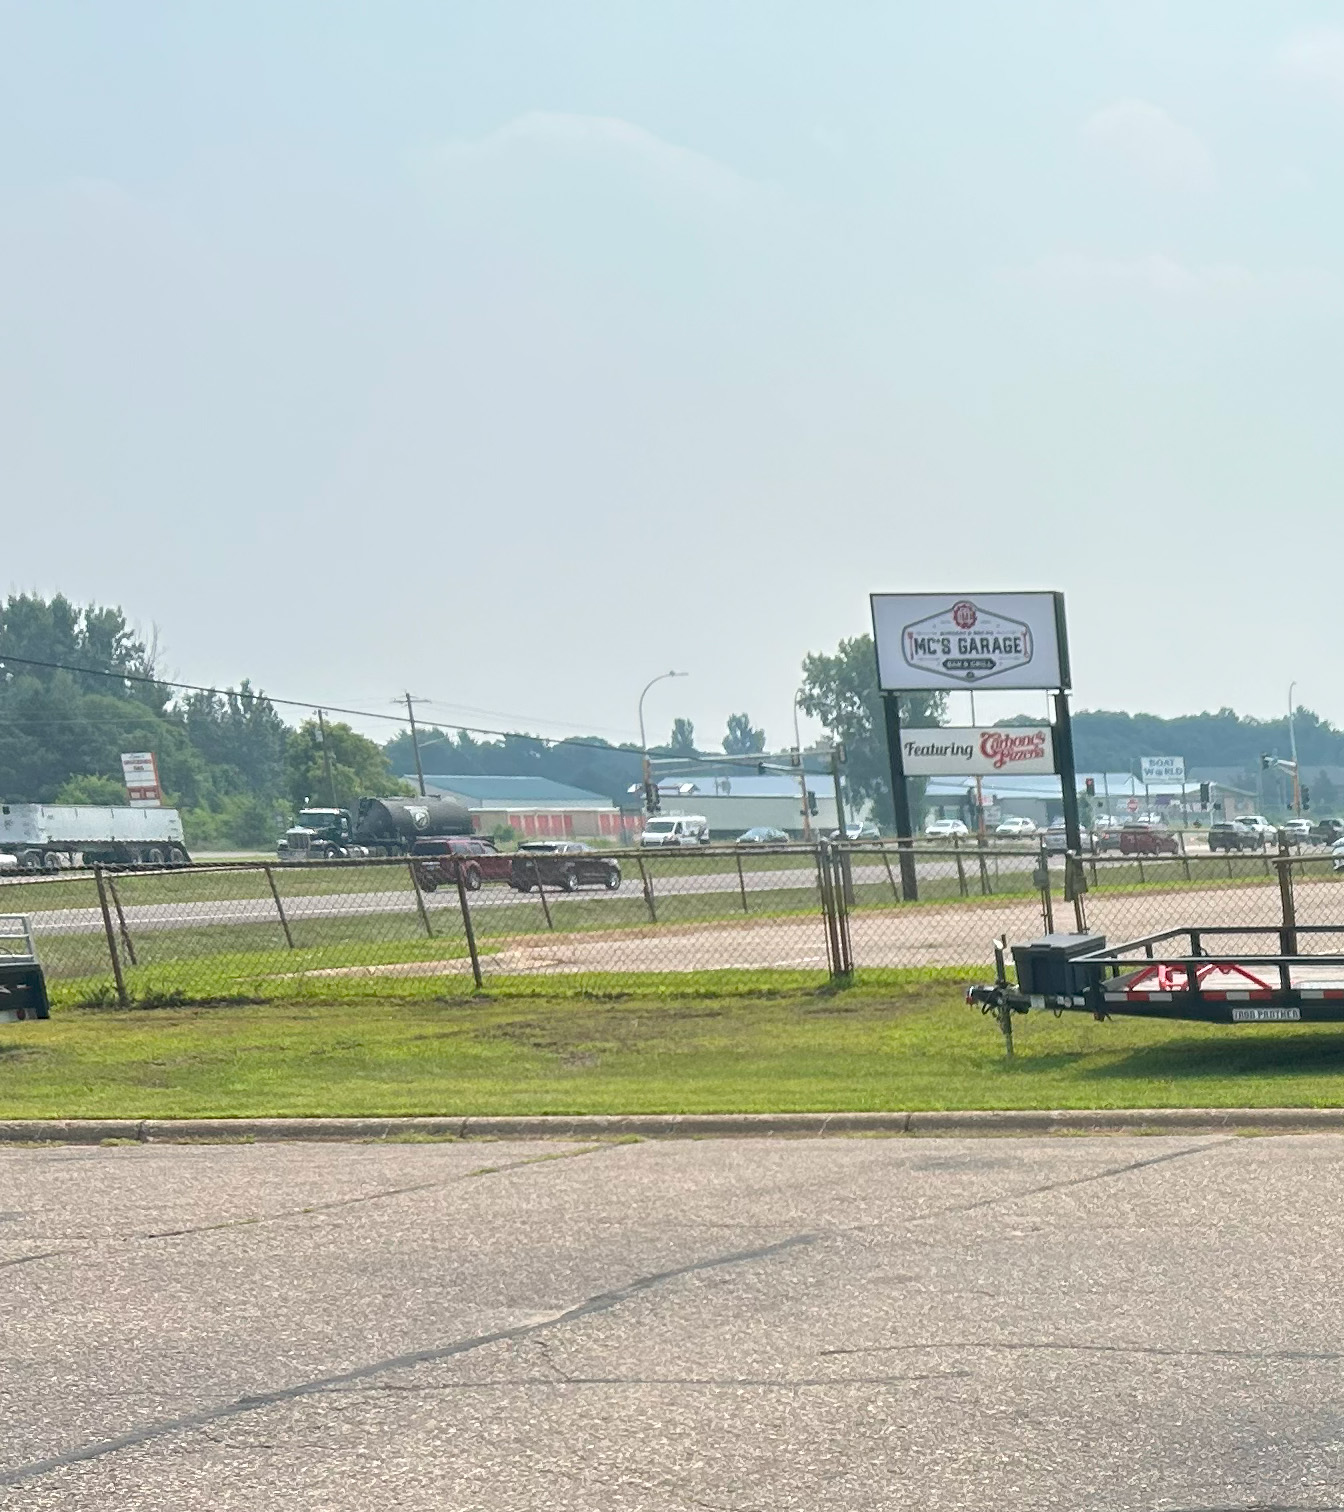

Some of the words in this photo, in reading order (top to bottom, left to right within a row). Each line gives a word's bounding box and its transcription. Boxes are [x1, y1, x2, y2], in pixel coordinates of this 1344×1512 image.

[914, 637, 951, 655] MC'S
[958, 637, 1023, 655] GARAGE
[904, 741, 974, 761] Featuring
